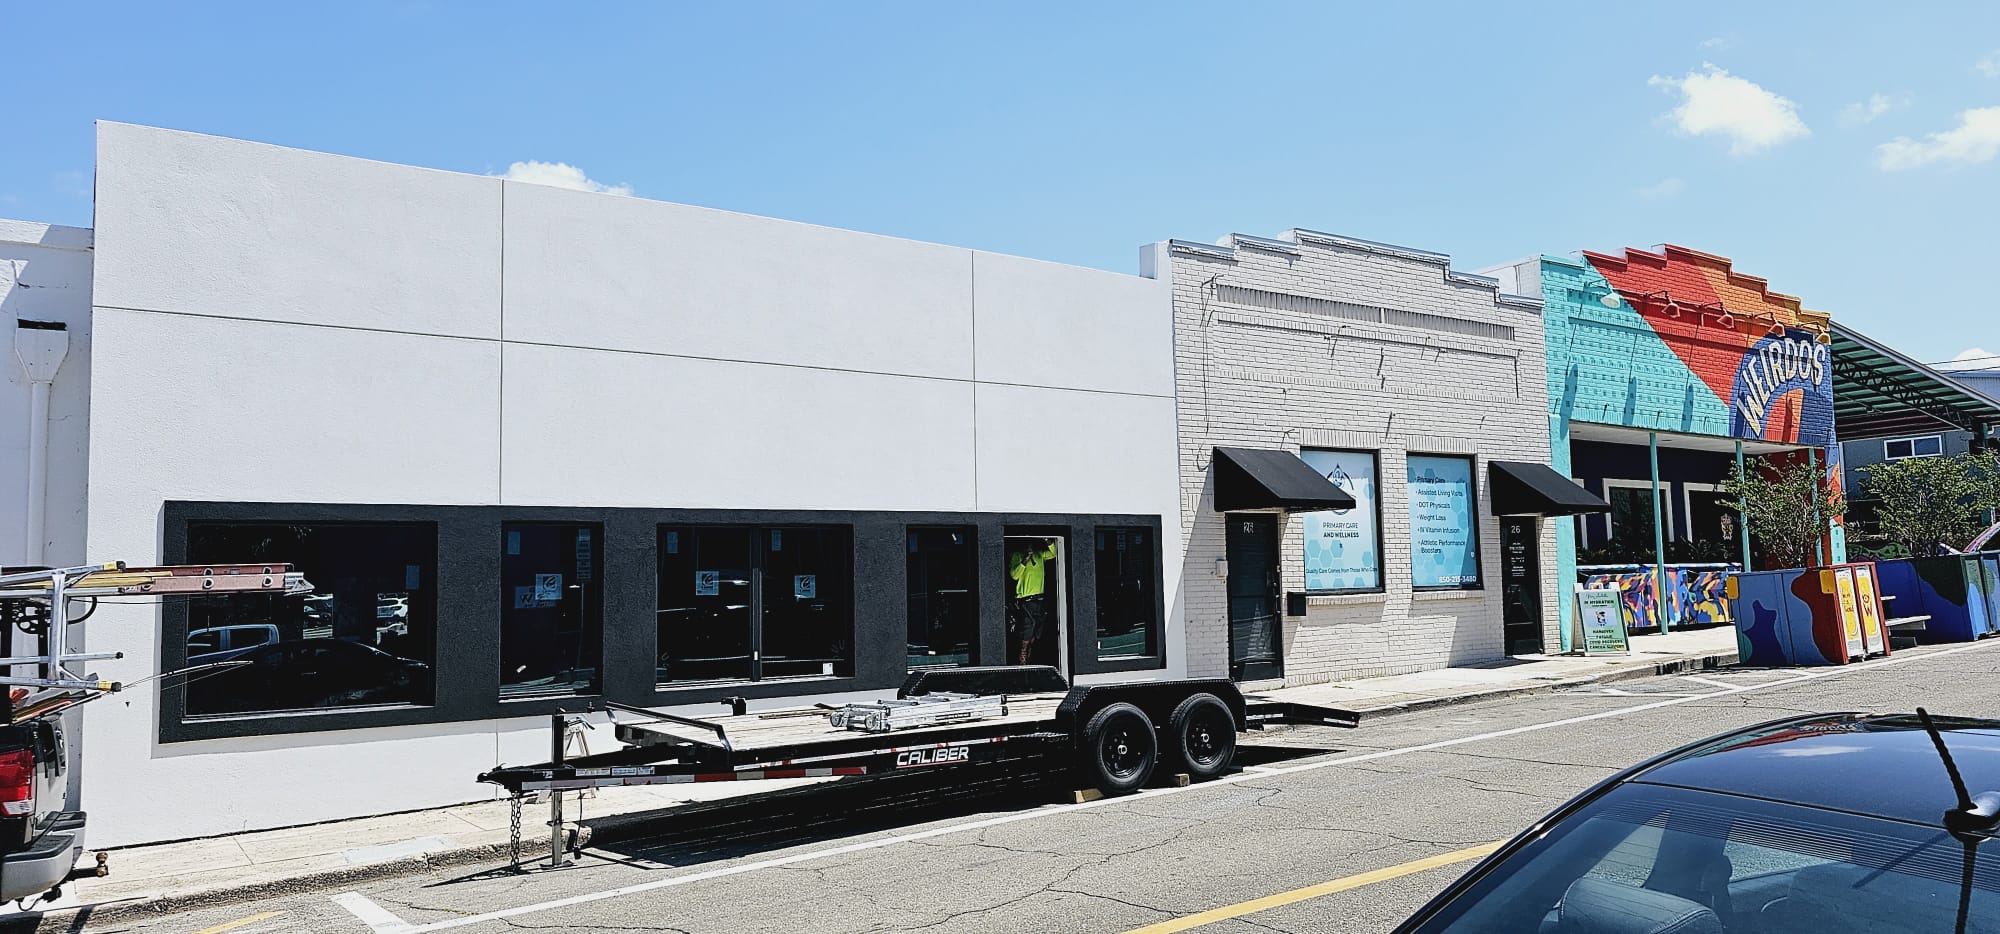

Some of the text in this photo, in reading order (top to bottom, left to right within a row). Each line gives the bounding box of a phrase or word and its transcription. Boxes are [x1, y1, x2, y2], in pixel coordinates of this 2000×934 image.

[1736, 337, 1826, 437] WEIRDOS
[1437, 490, 1450, 498] Living
[1430, 502, 1451, 510] Physicals
[1419, 514, 1435, 522] Weight
[1322, 521, 1345, 529] PRIMARY
[1511, 525, 1521, 534] 26
[896, 746, 969, 766] CALIBER
